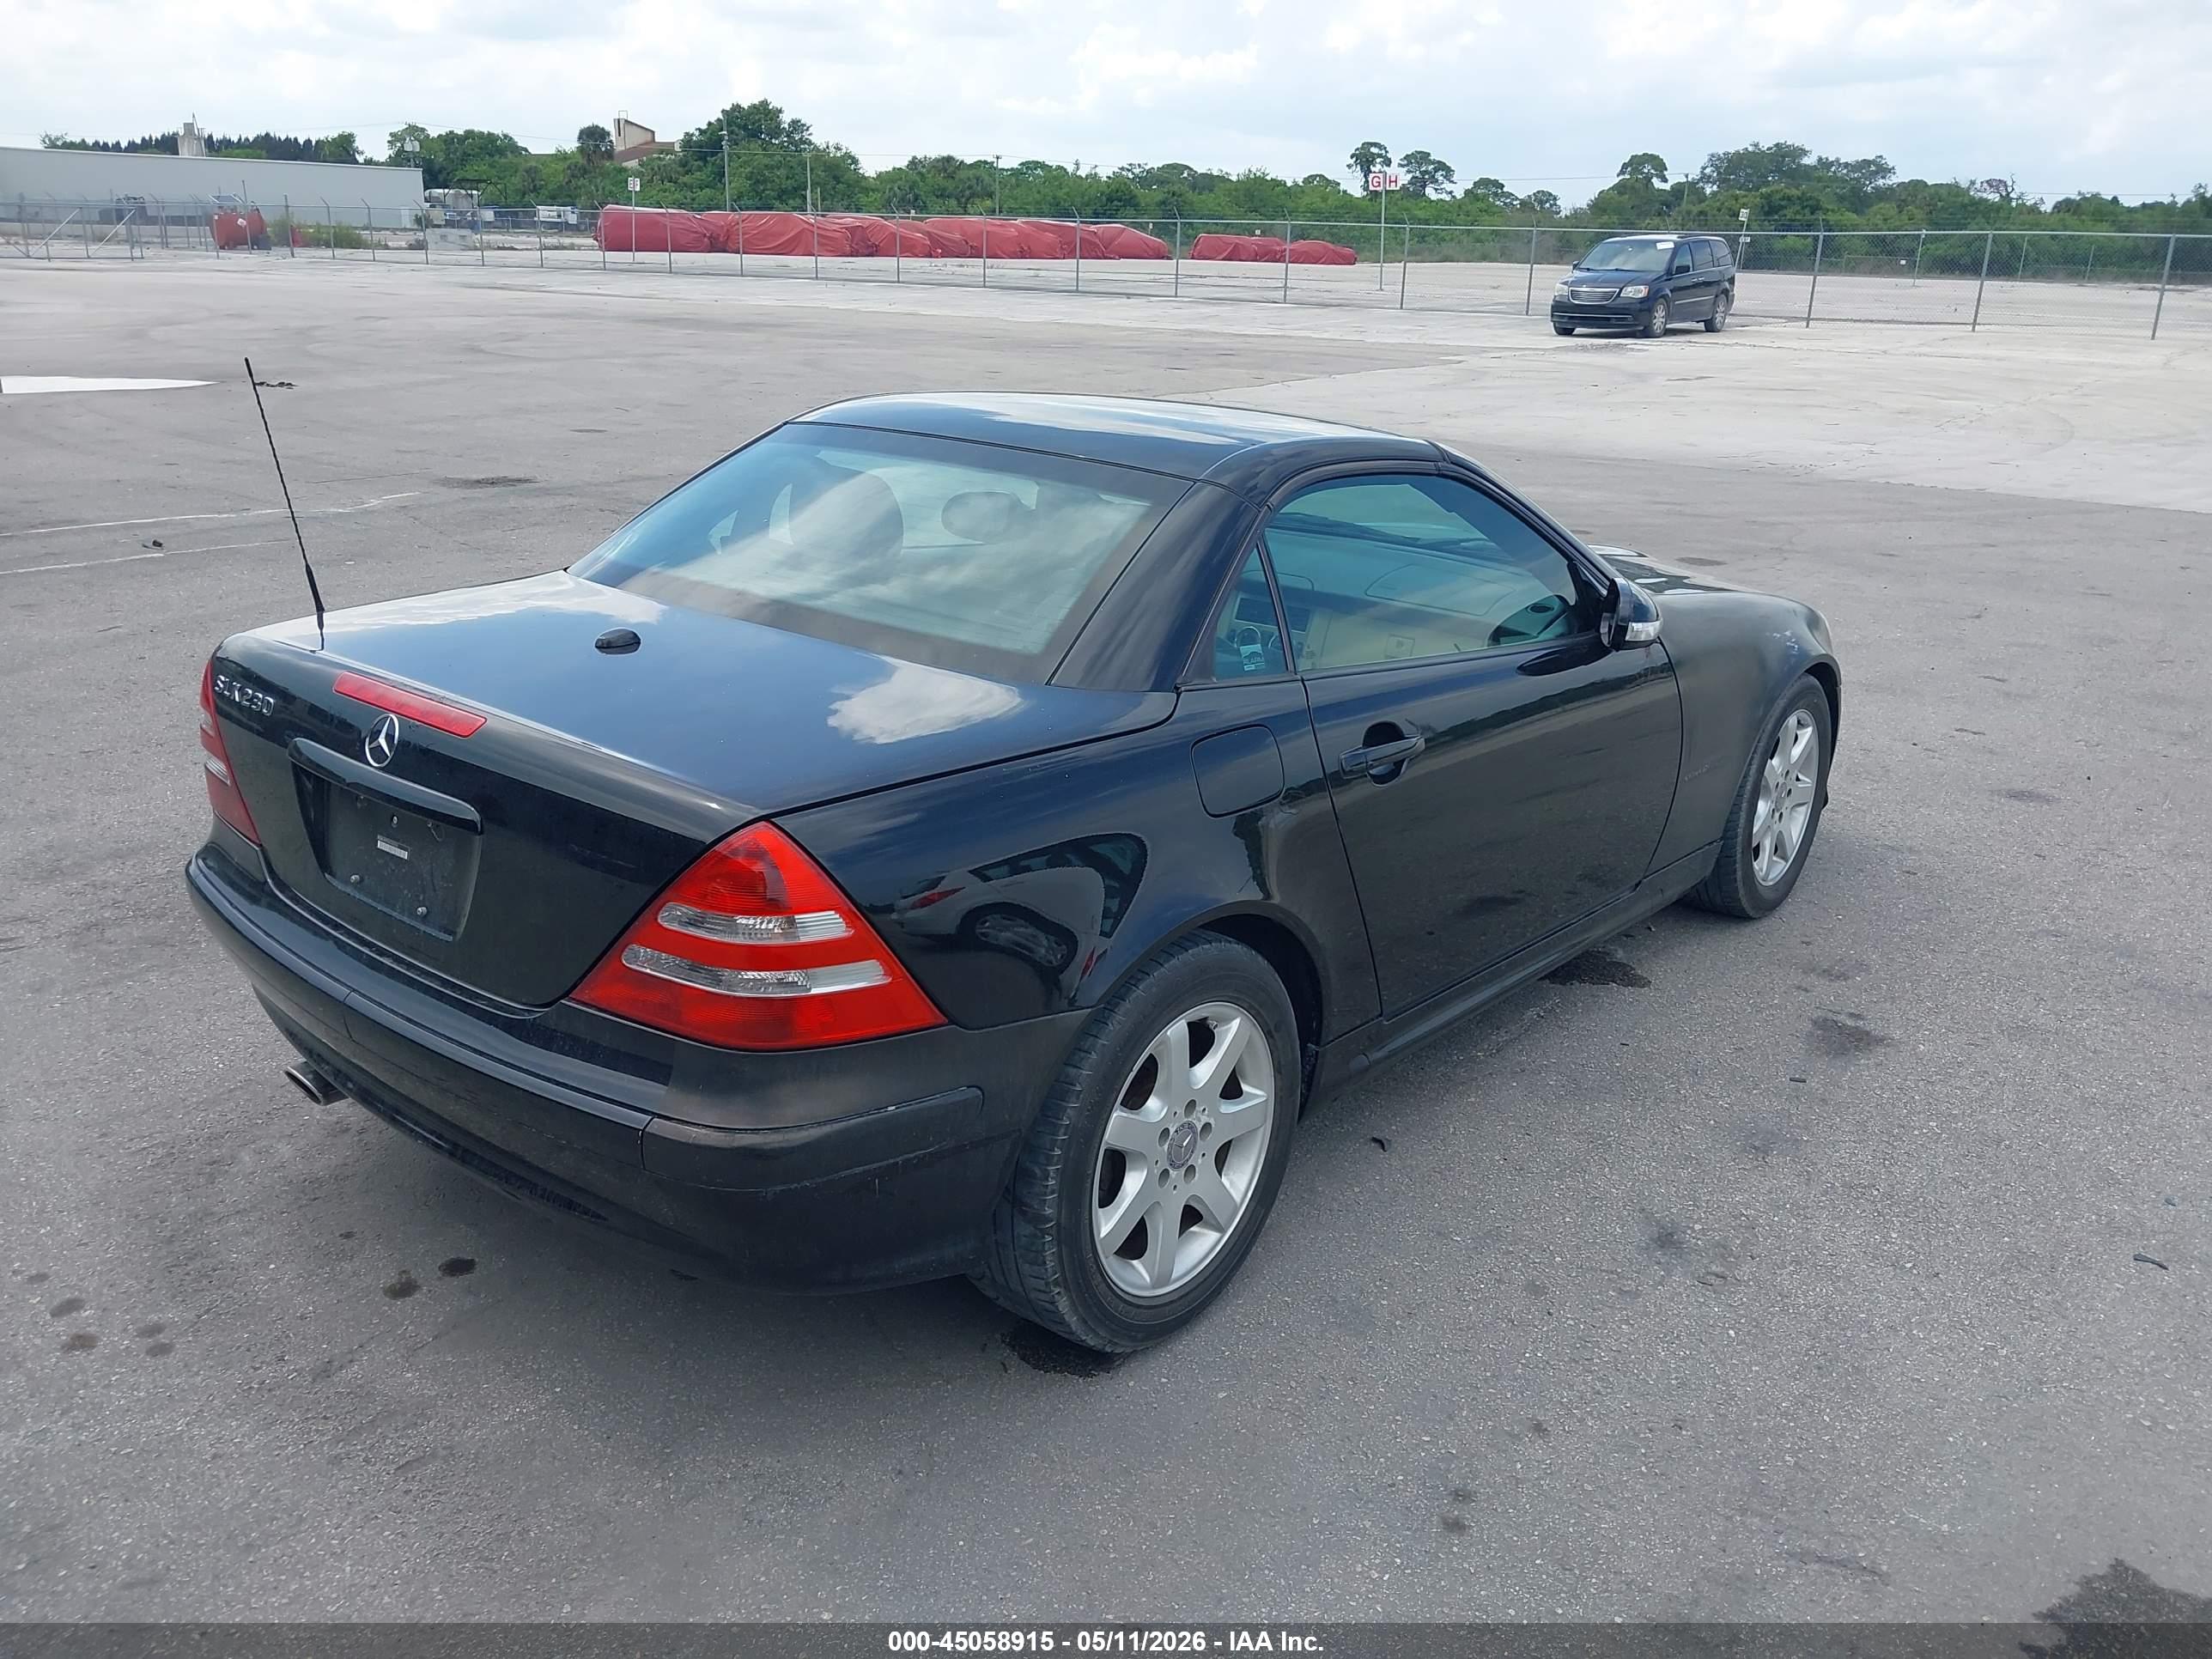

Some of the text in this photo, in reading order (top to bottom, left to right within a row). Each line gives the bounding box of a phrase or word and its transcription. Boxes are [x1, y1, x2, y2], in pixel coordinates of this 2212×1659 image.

[1370, 174, 1398, 188] G H
[213, 675, 274, 716] SLK230
